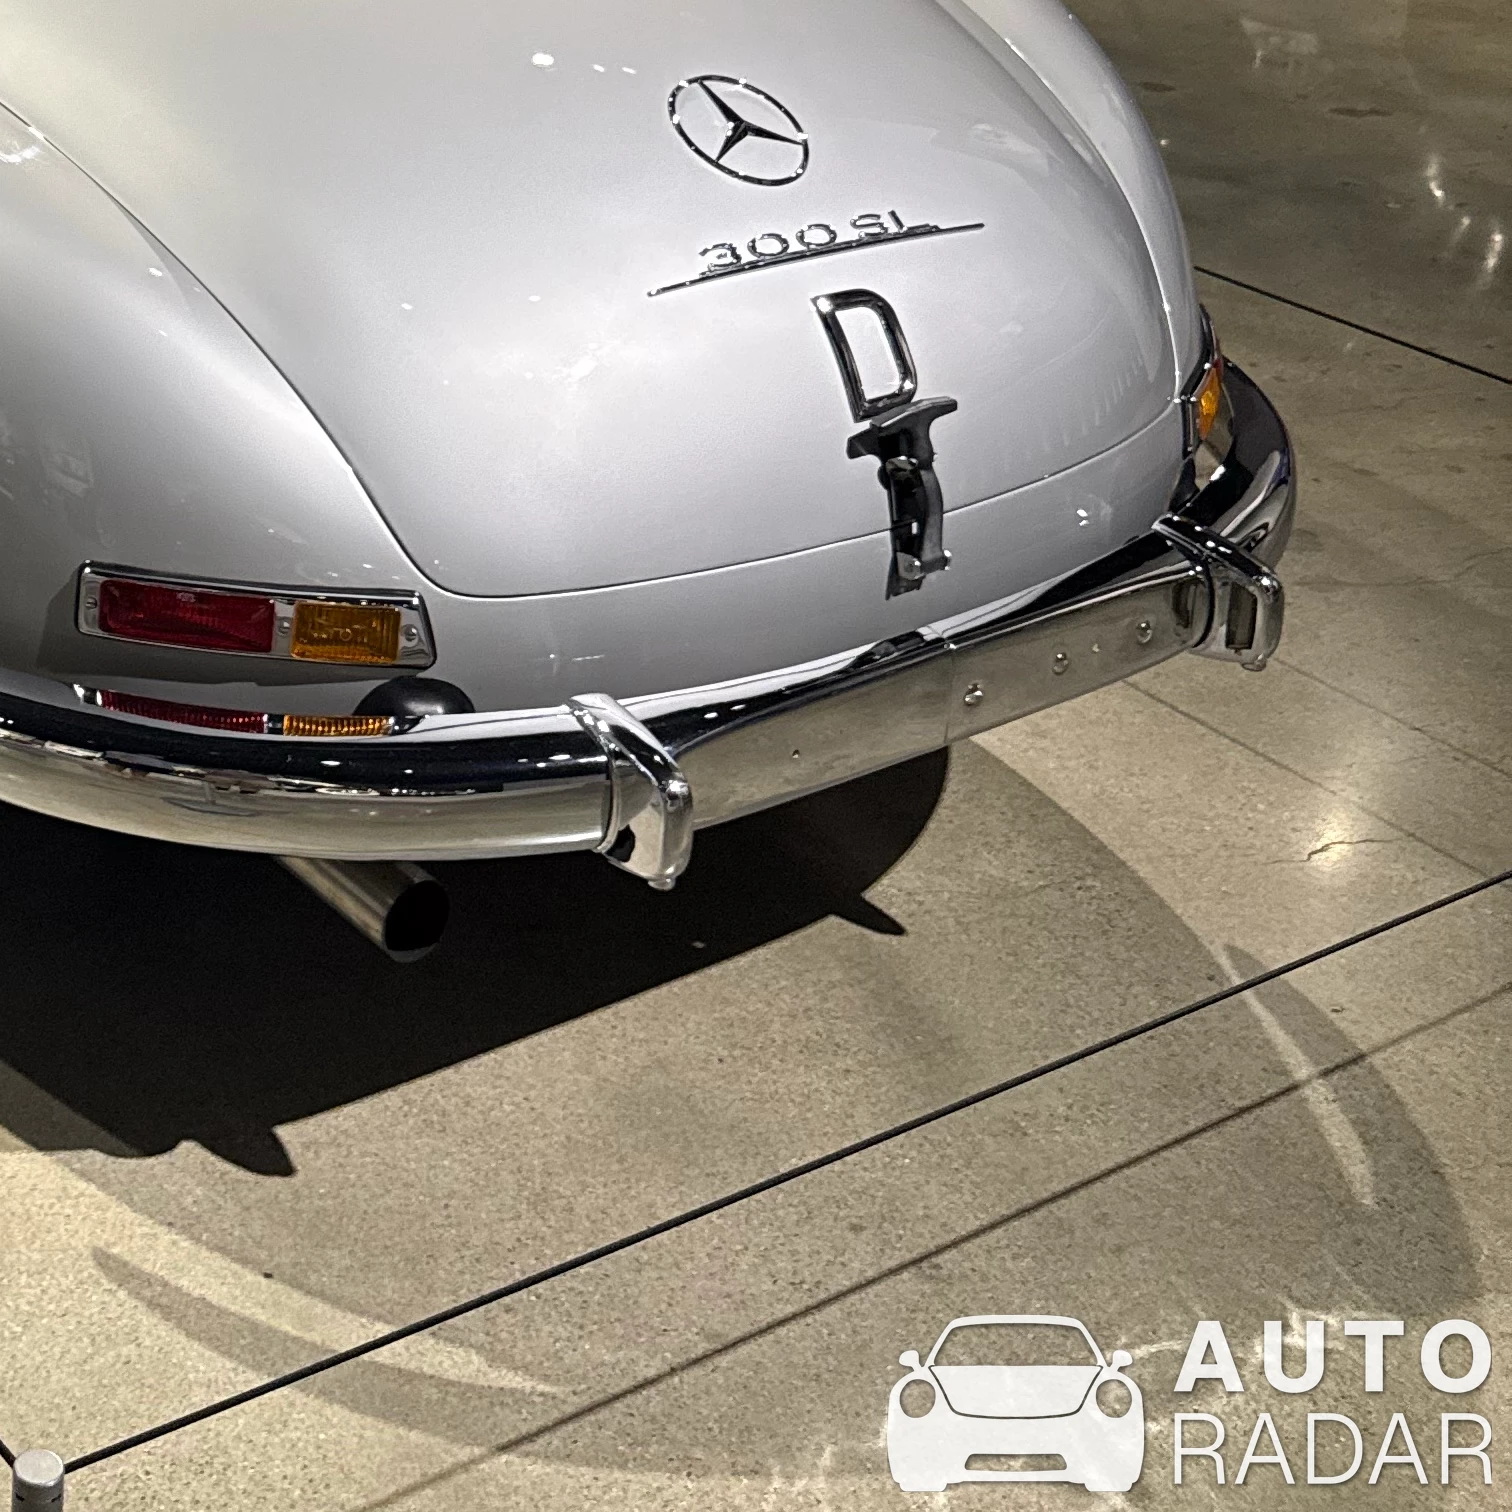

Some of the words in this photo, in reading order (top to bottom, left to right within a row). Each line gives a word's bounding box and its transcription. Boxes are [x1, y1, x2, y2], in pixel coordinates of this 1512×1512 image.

[699, 223, 837, 272] 300
[849, 210, 939, 238] SL
[810, 289, 917, 423] D
